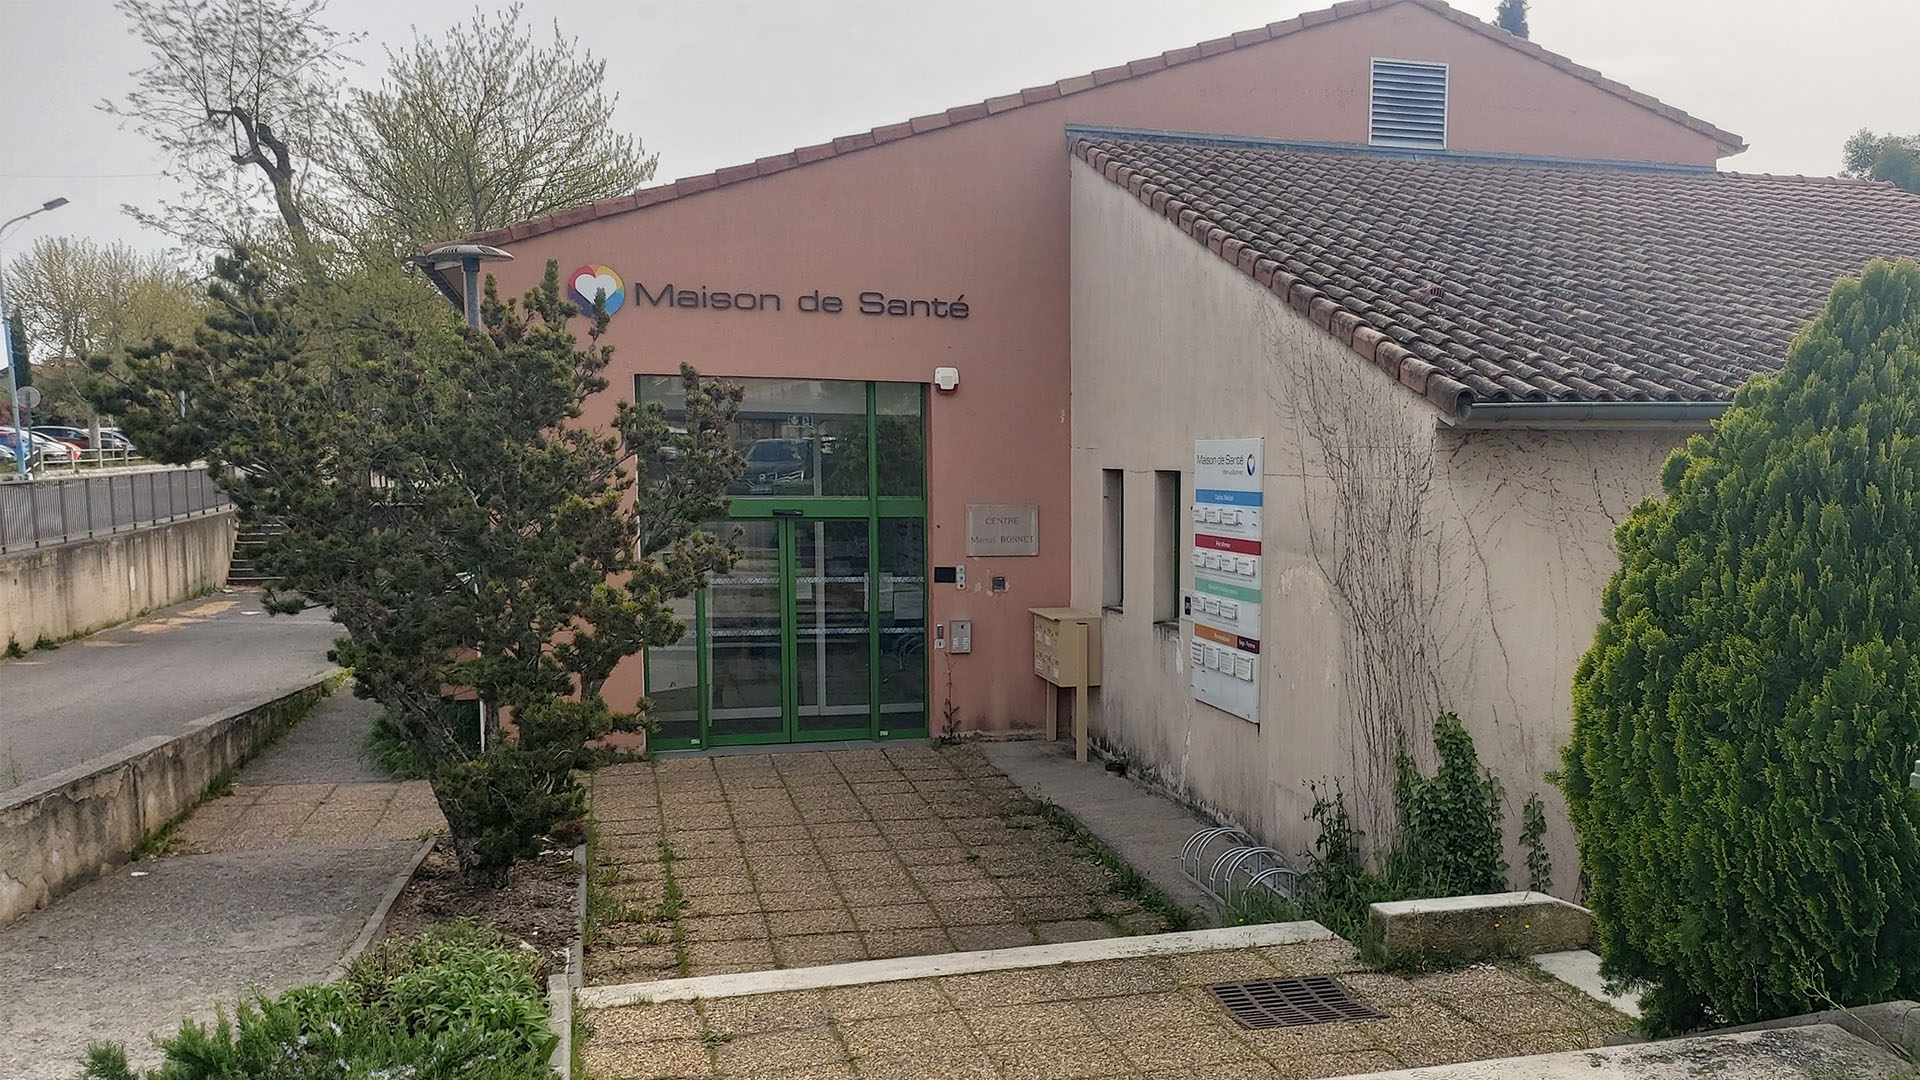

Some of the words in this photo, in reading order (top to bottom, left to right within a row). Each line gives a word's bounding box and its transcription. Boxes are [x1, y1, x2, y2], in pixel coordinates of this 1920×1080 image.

[635, 282, 781, 312] Maison
[798, 290, 843, 313] de
[859, 291, 970, 319] Santé
[1196, 454, 1217, 465] Maison
[1218, 454, 1225, 465] de
[1225, 453, 1244, 466] Santé
[985, 516, 1019, 526] CENTRE
[1000, 535, 1034, 544] BONNET
